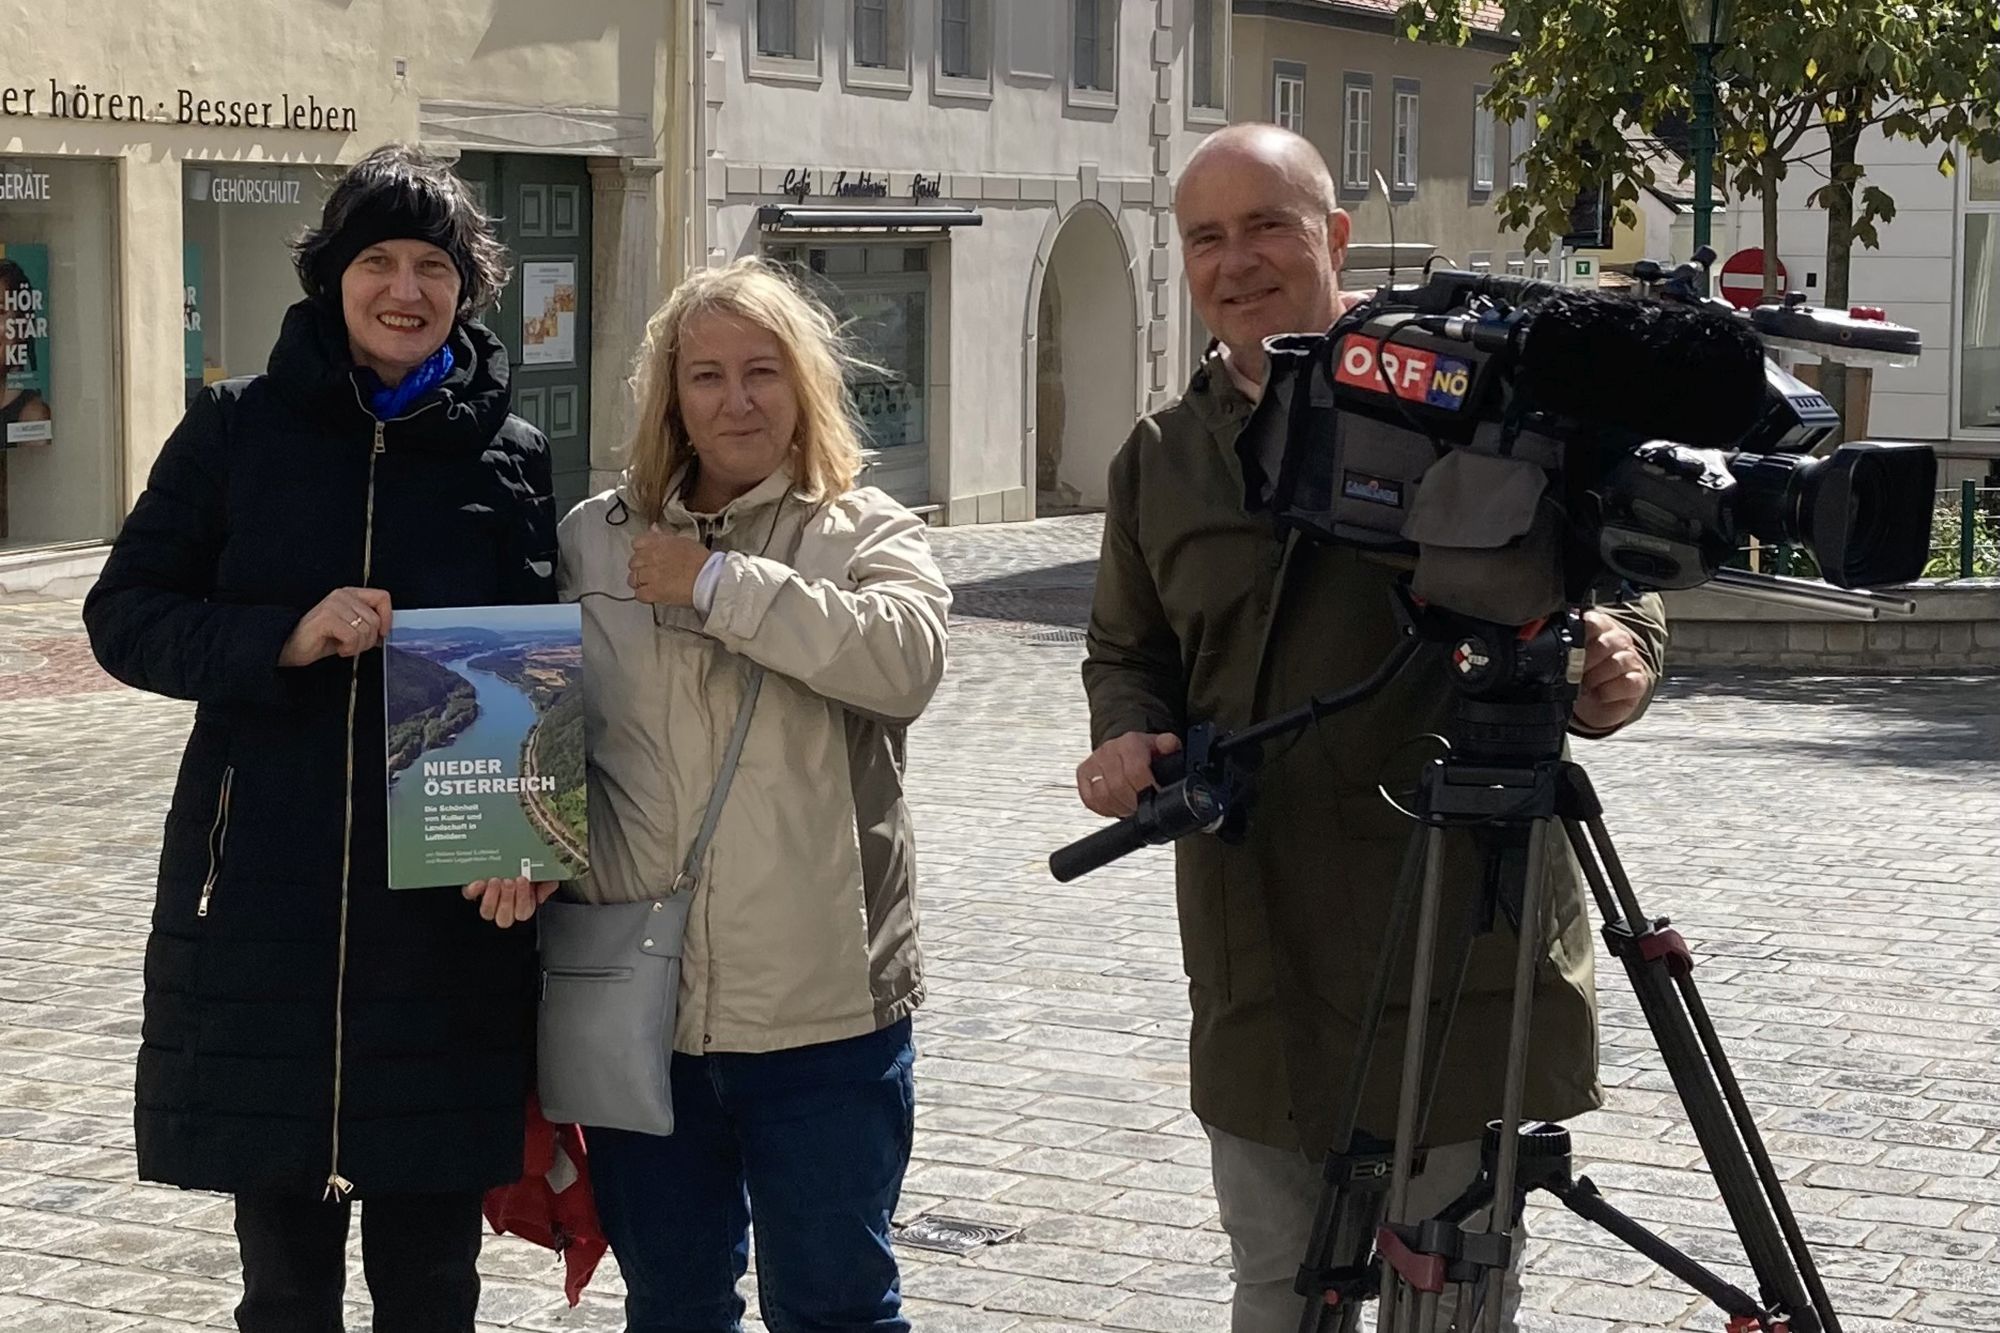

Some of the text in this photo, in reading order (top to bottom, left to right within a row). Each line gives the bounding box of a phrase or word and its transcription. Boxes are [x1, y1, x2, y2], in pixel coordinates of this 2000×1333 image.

[49, 78, 146, 122] hören
[177, 89, 272, 128] Besser
[282, 93, 358, 132] leben
[212, 174, 300, 204] GEHÖRSCHUTZ
[5, 283, 43, 312] HÖR
[5, 314, 48, 340] STÄR
[5, 344, 28, 366] KE
[1344, 345, 1469, 396] ORF NÖ
[424, 759, 502, 776] NIEDER
[424, 776, 556, 797] ÖSTERREICH
[424, 804, 479, 813] Die Schönheit
[441, 814, 465, 822] Kultur
[467, 813, 482, 821] und
[424, 823, 468, 832] Landschaft
[424, 833, 467, 841] Luftbildern
